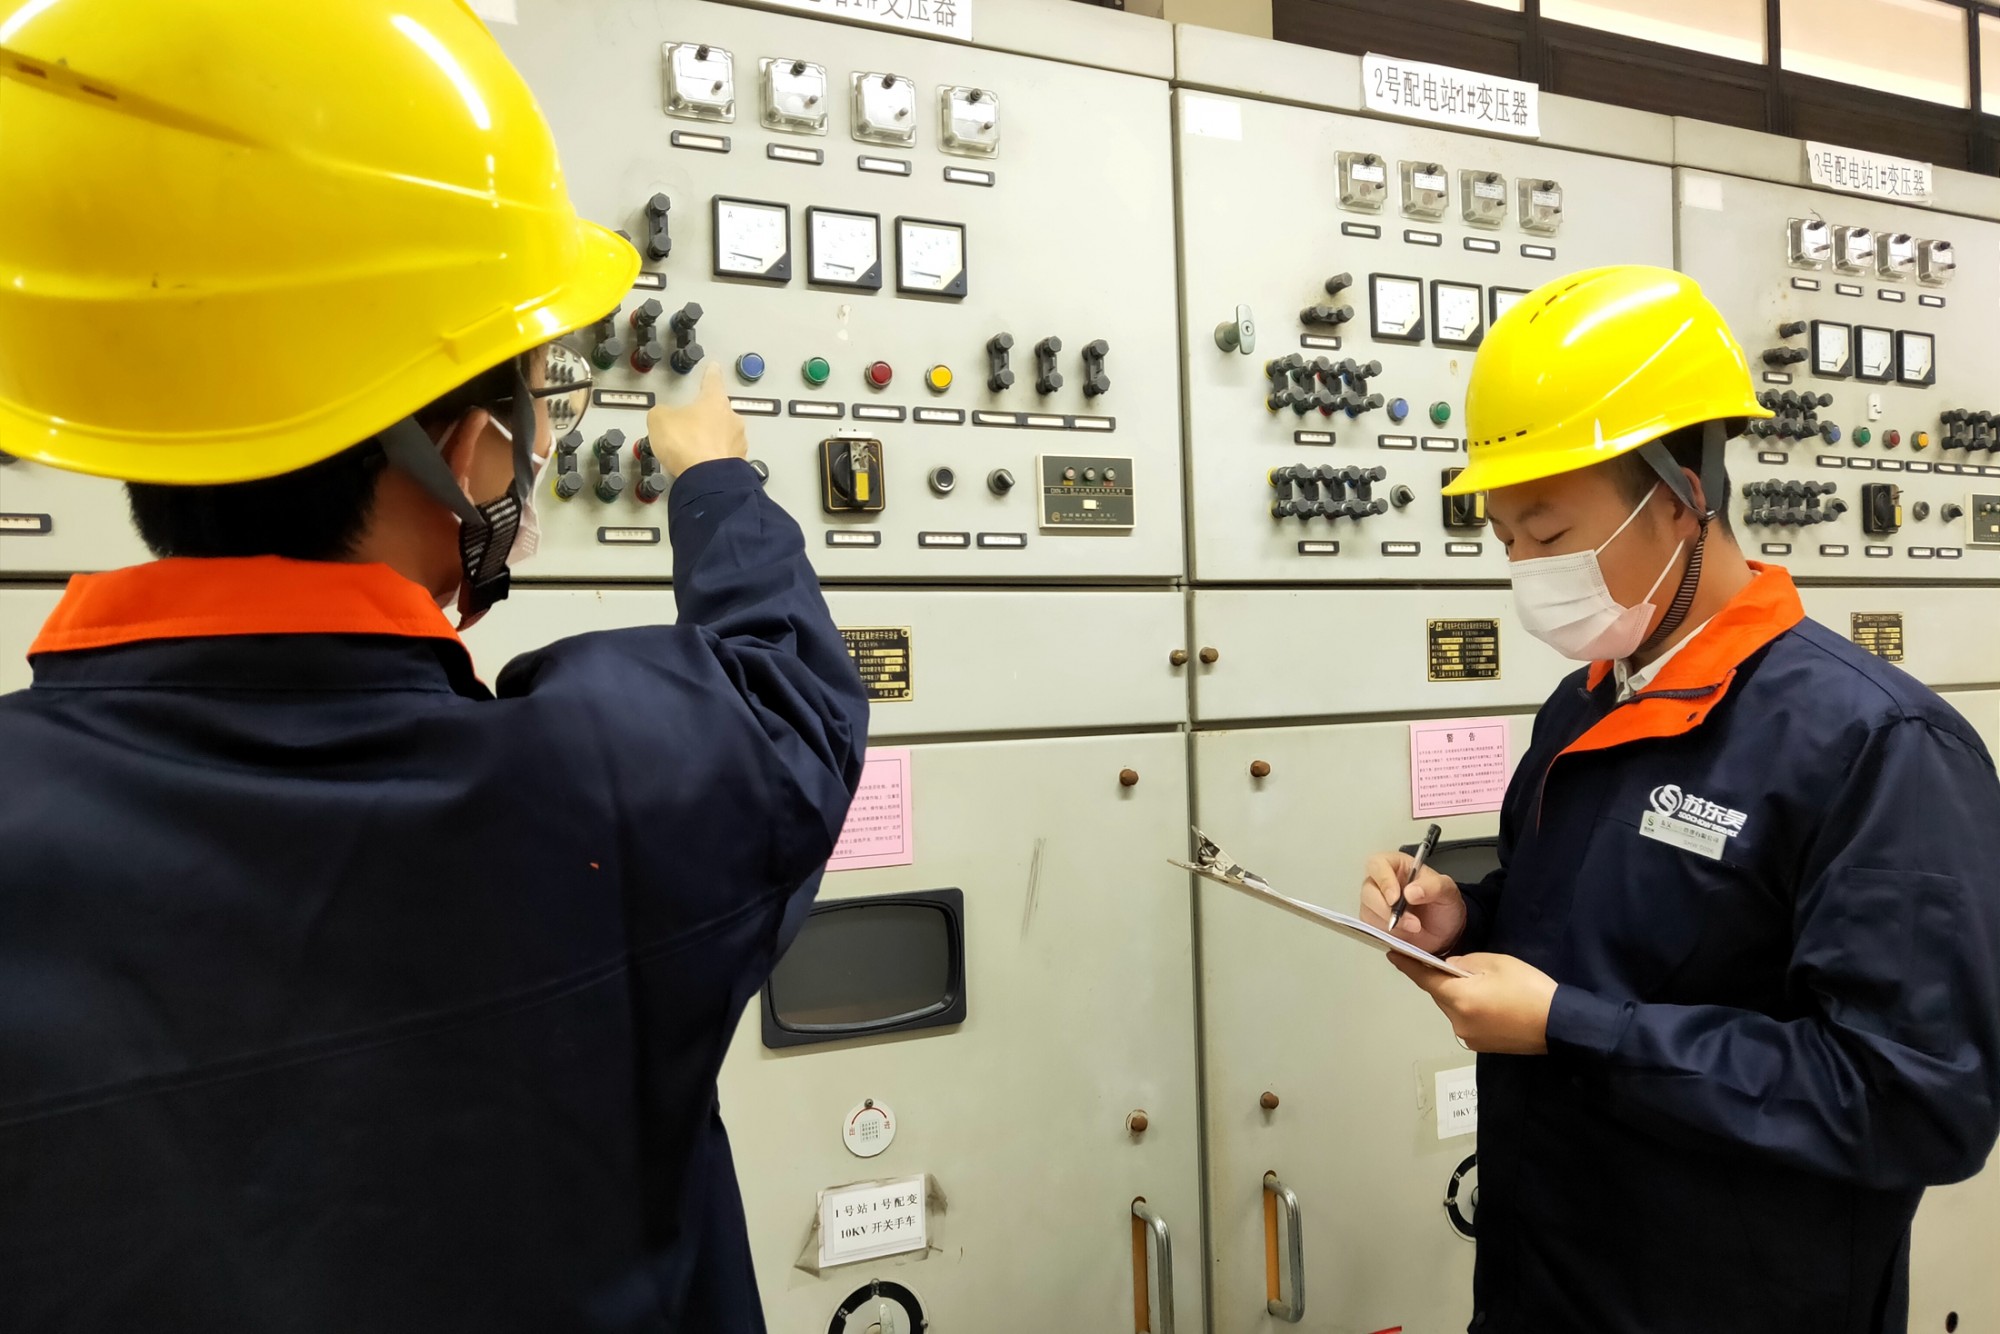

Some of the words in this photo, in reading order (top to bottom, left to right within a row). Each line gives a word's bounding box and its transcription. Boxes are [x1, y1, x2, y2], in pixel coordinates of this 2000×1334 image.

[1374, 66, 1528, 126] 2号配电站1#变压器
[1814, 152, 1926, 196] 3号配电站1#变压器
[1453, 1107, 1471, 1118] 10KV
[841, 1225, 868, 1239] 10KV
[872, 1215, 916, 1234] 开关手车
